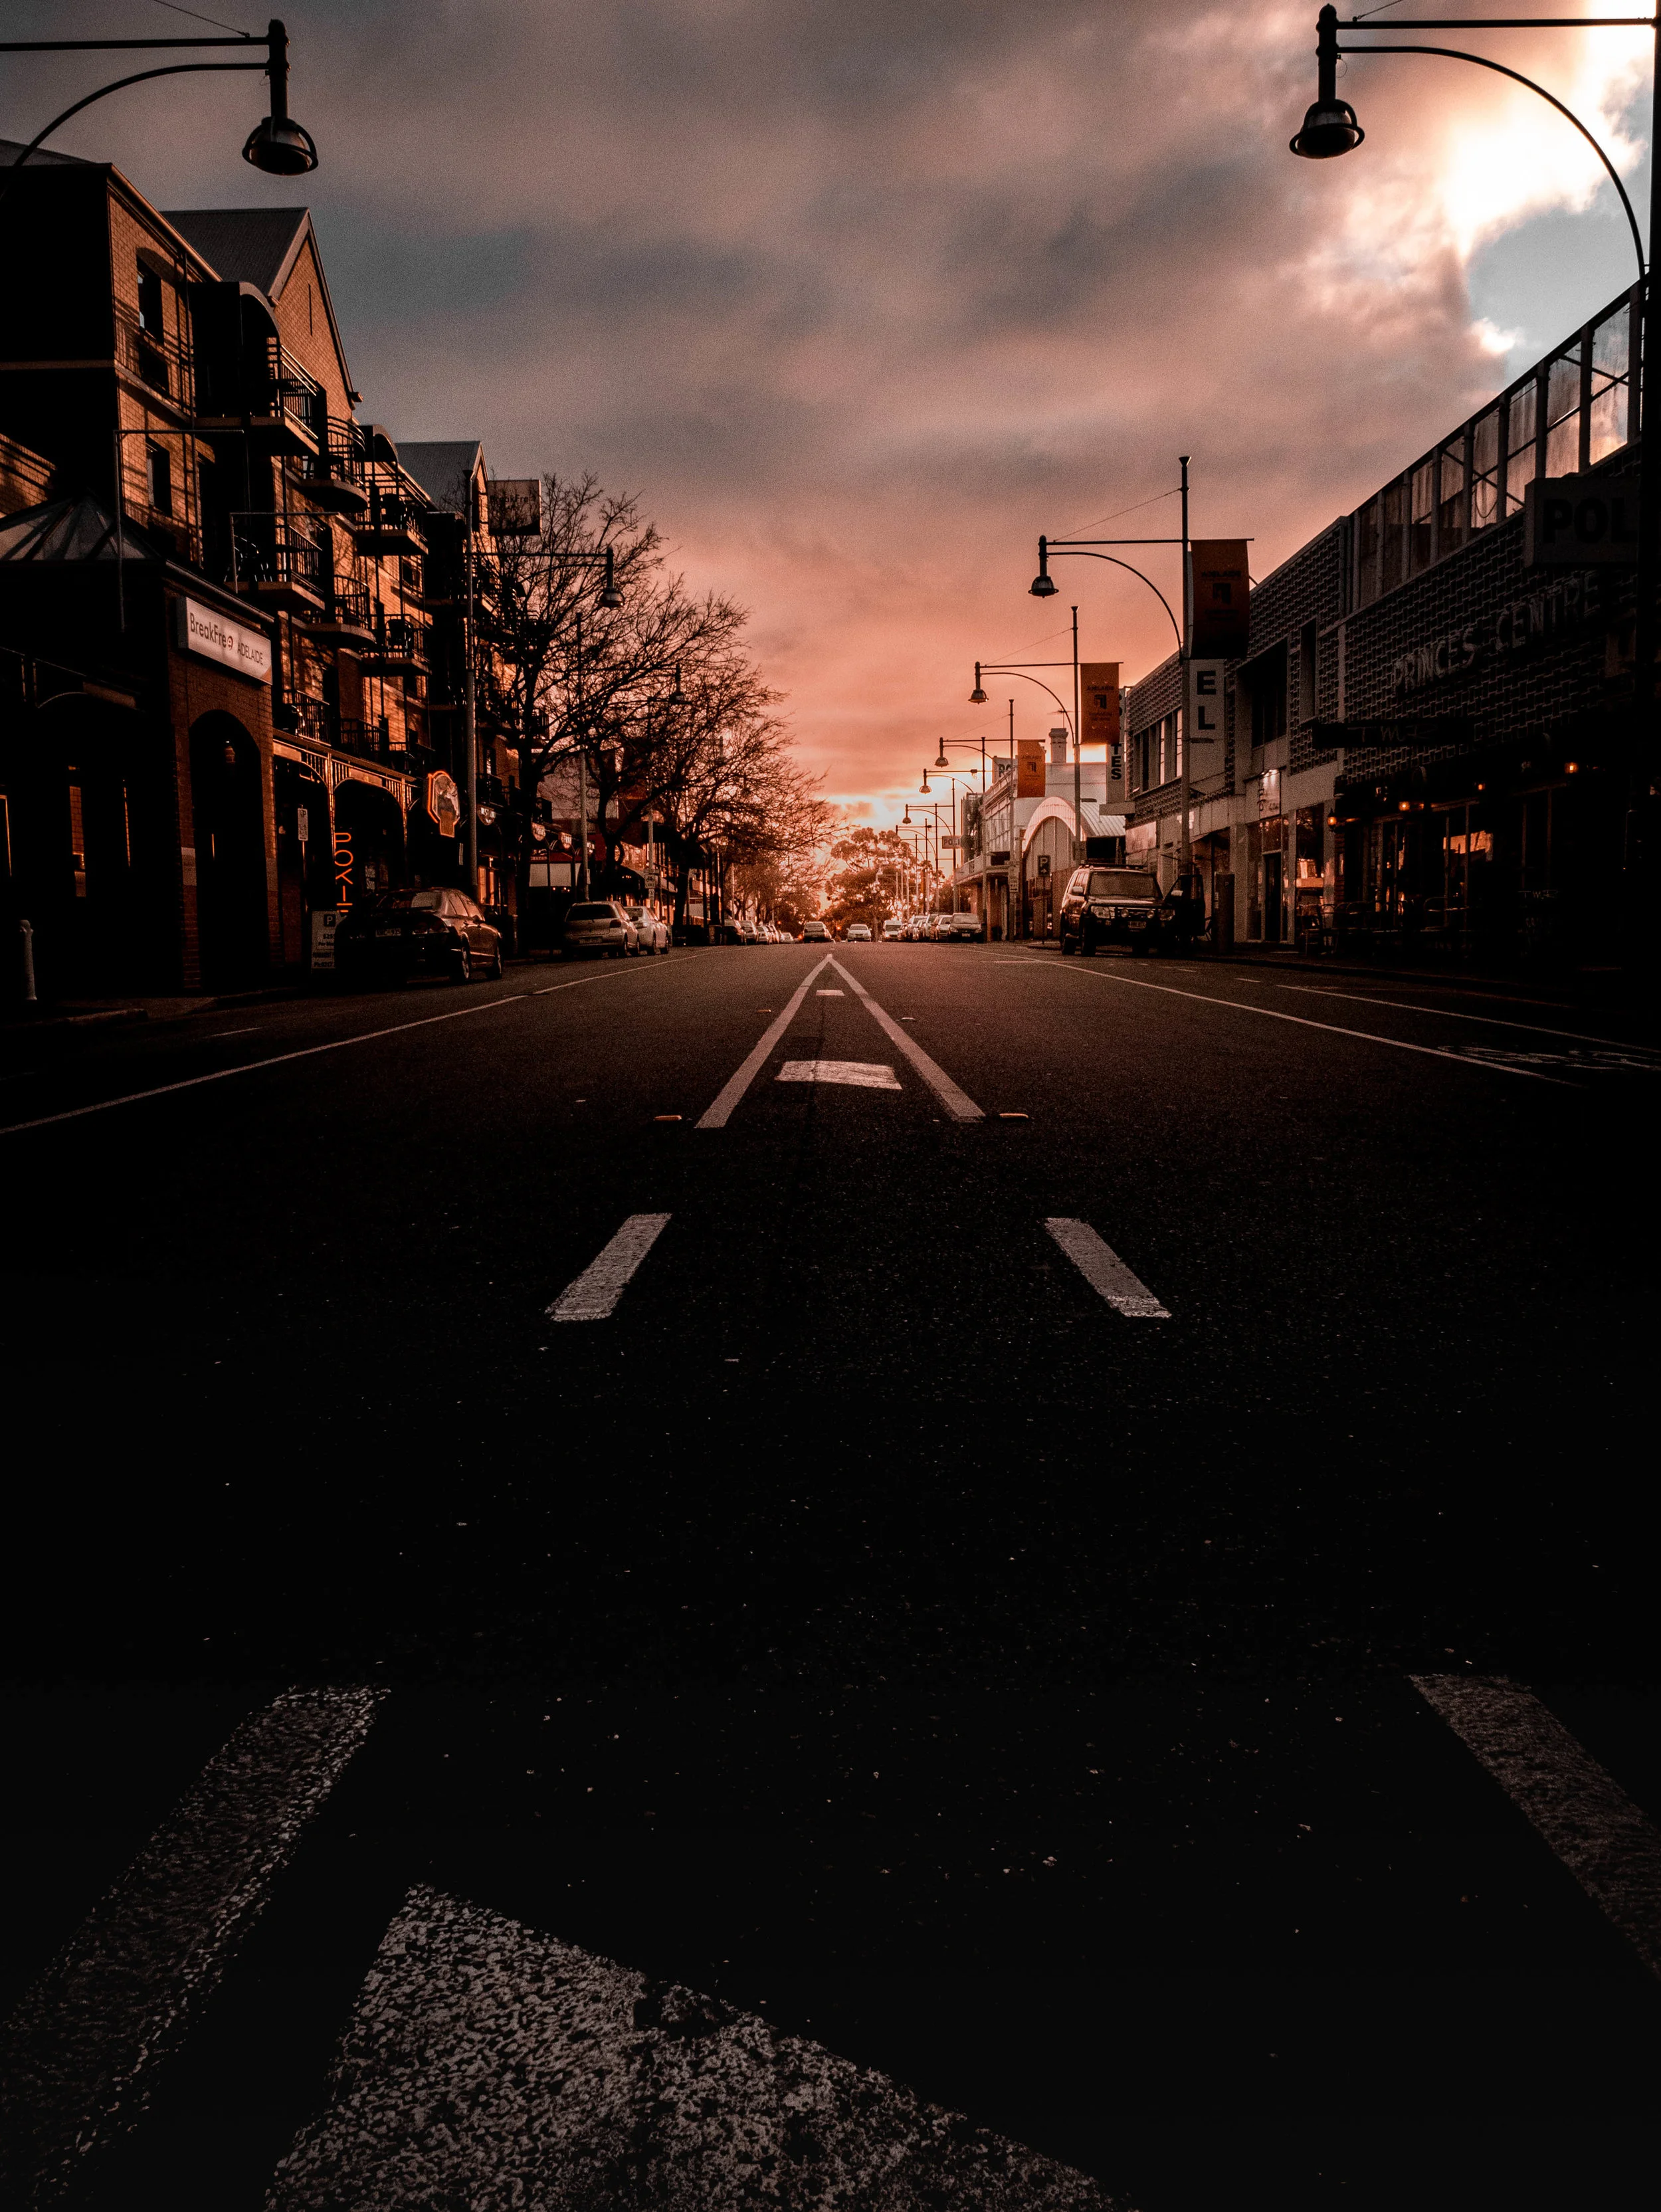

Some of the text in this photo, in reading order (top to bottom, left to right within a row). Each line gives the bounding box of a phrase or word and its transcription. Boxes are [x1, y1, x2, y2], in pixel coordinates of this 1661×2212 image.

[1496, 570, 1601, 651] CENTRE
[190, 613, 263, 665] BreakFree ADELAIDE
[1040, 856, 1048, 867] P
[326, 916, 334, 926] P
